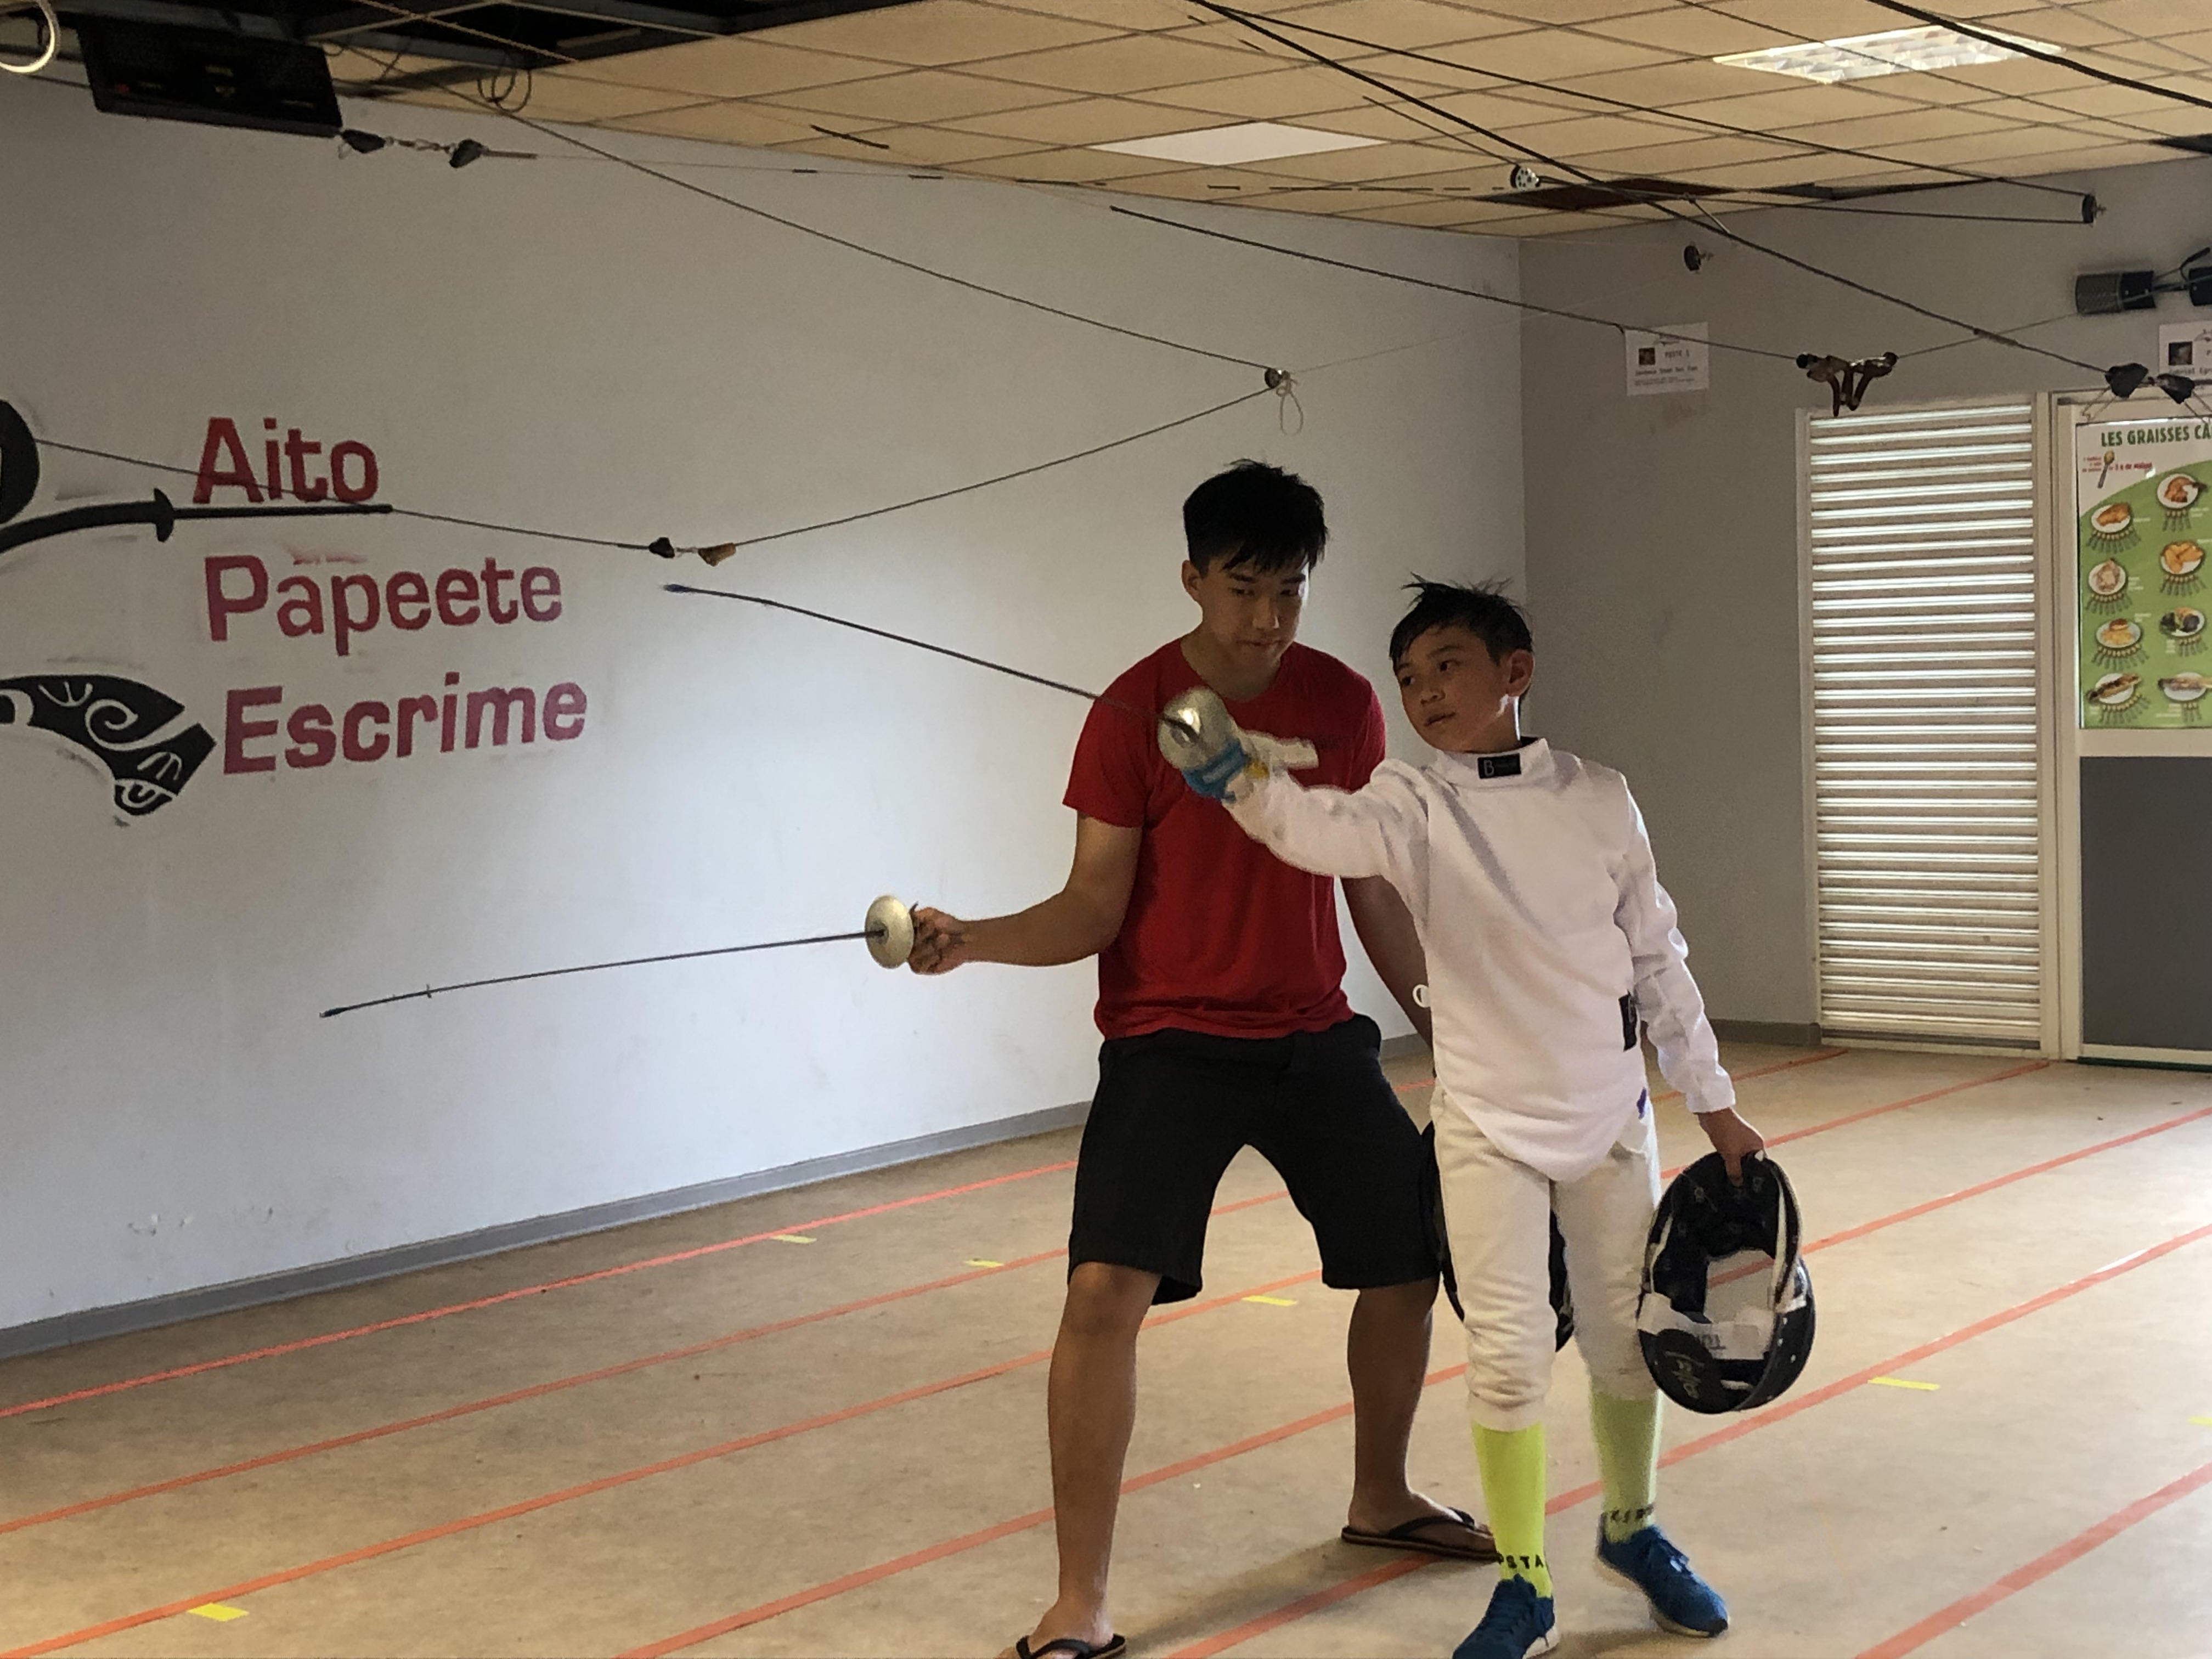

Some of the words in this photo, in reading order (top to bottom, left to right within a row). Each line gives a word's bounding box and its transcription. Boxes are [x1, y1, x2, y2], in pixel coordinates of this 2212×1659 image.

[193, 417, 379, 504] Aito
[2101, 431, 2123, 447] LES
[2127, 426, 2190, 445] GRAISSES
[2194, 423, 2212, 439] CA
[204, 555, 562, 657] Papeete
[223, 671, 588, 775] Escrime
